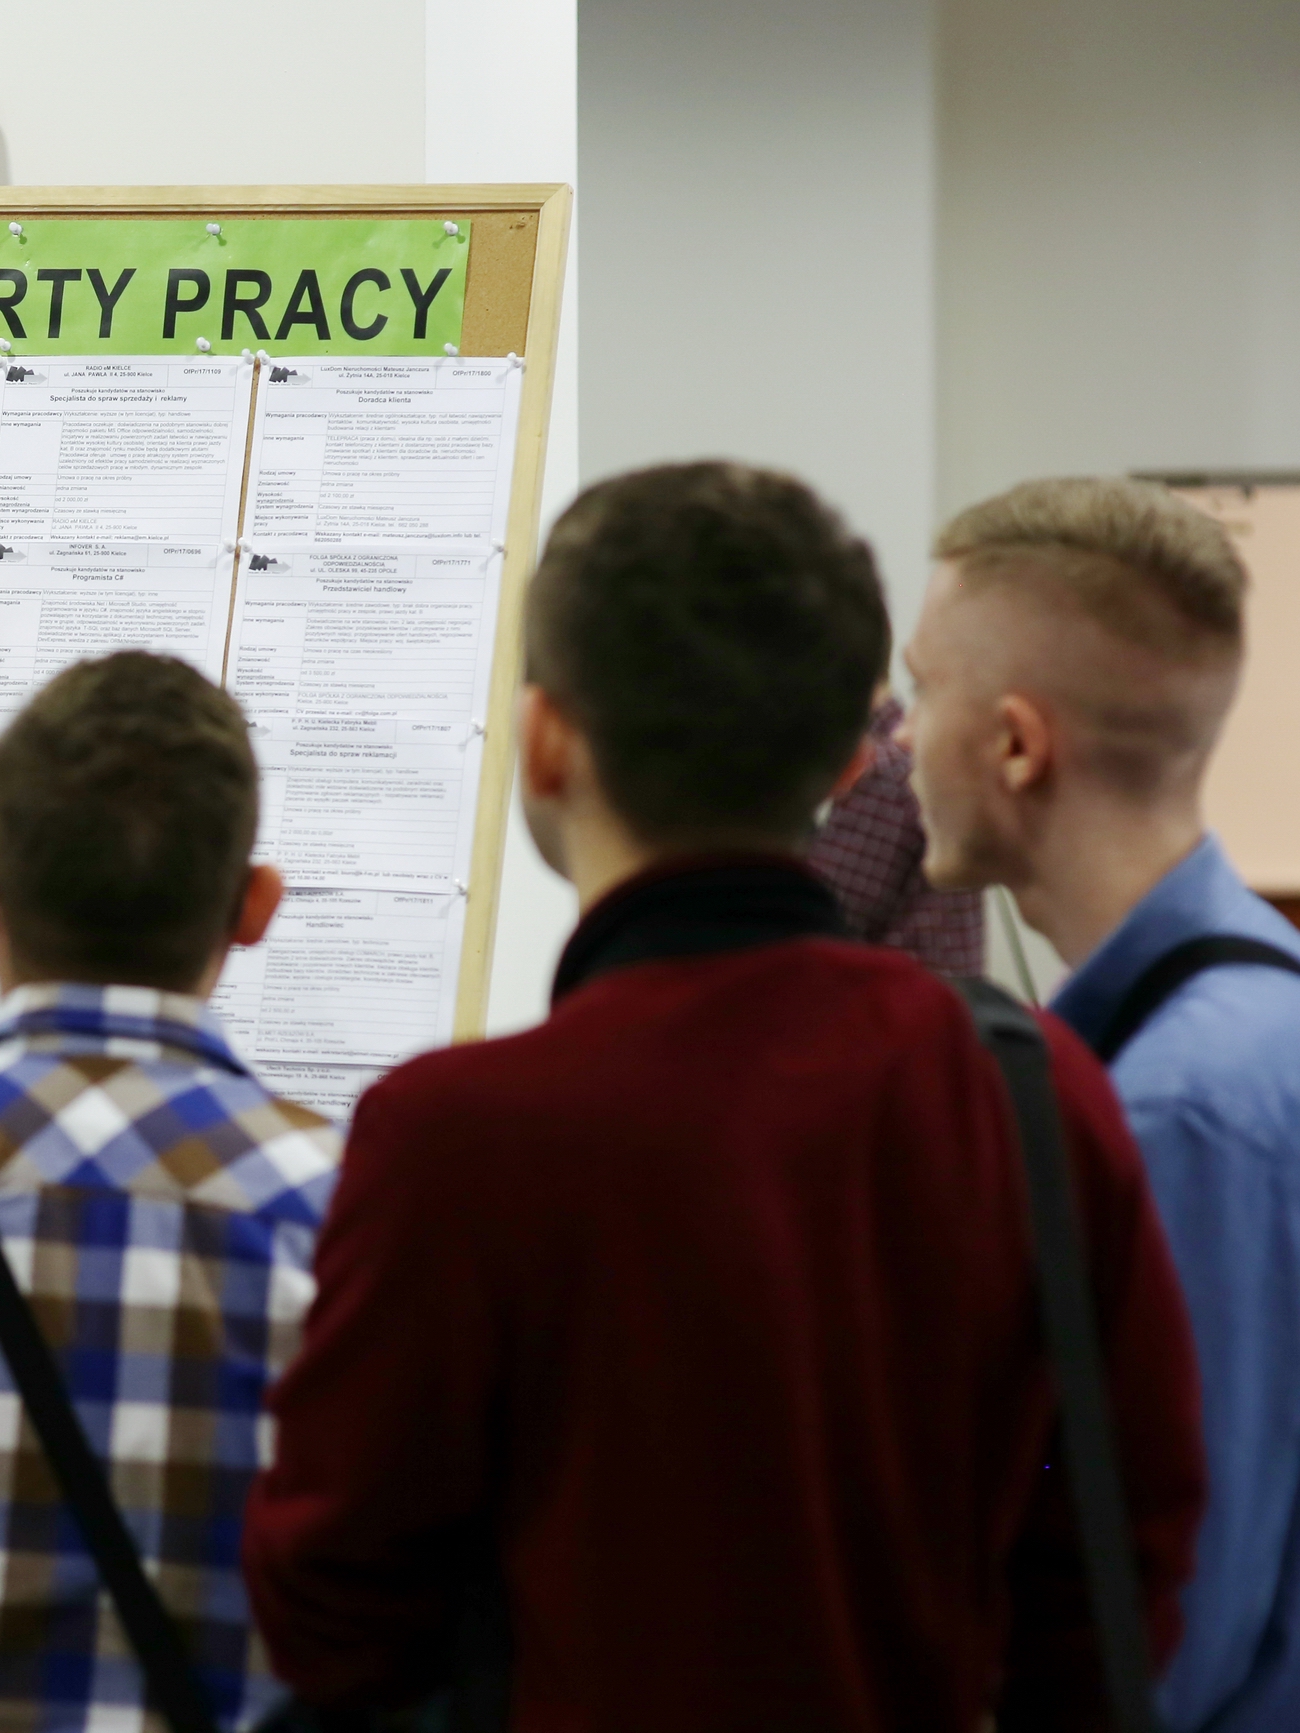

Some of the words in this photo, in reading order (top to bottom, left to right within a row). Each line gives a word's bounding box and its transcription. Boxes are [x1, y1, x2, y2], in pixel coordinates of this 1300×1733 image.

[162, 267, 452, 341] PRACY
[49, 394, 86, 402] Specjalista
[119, 395, 153, 403] sprzedaży
[160, 395, 187, 403] reklamy
[72, 574, 113, 582] Programista
[373, 586, 407, 594] handlowy
